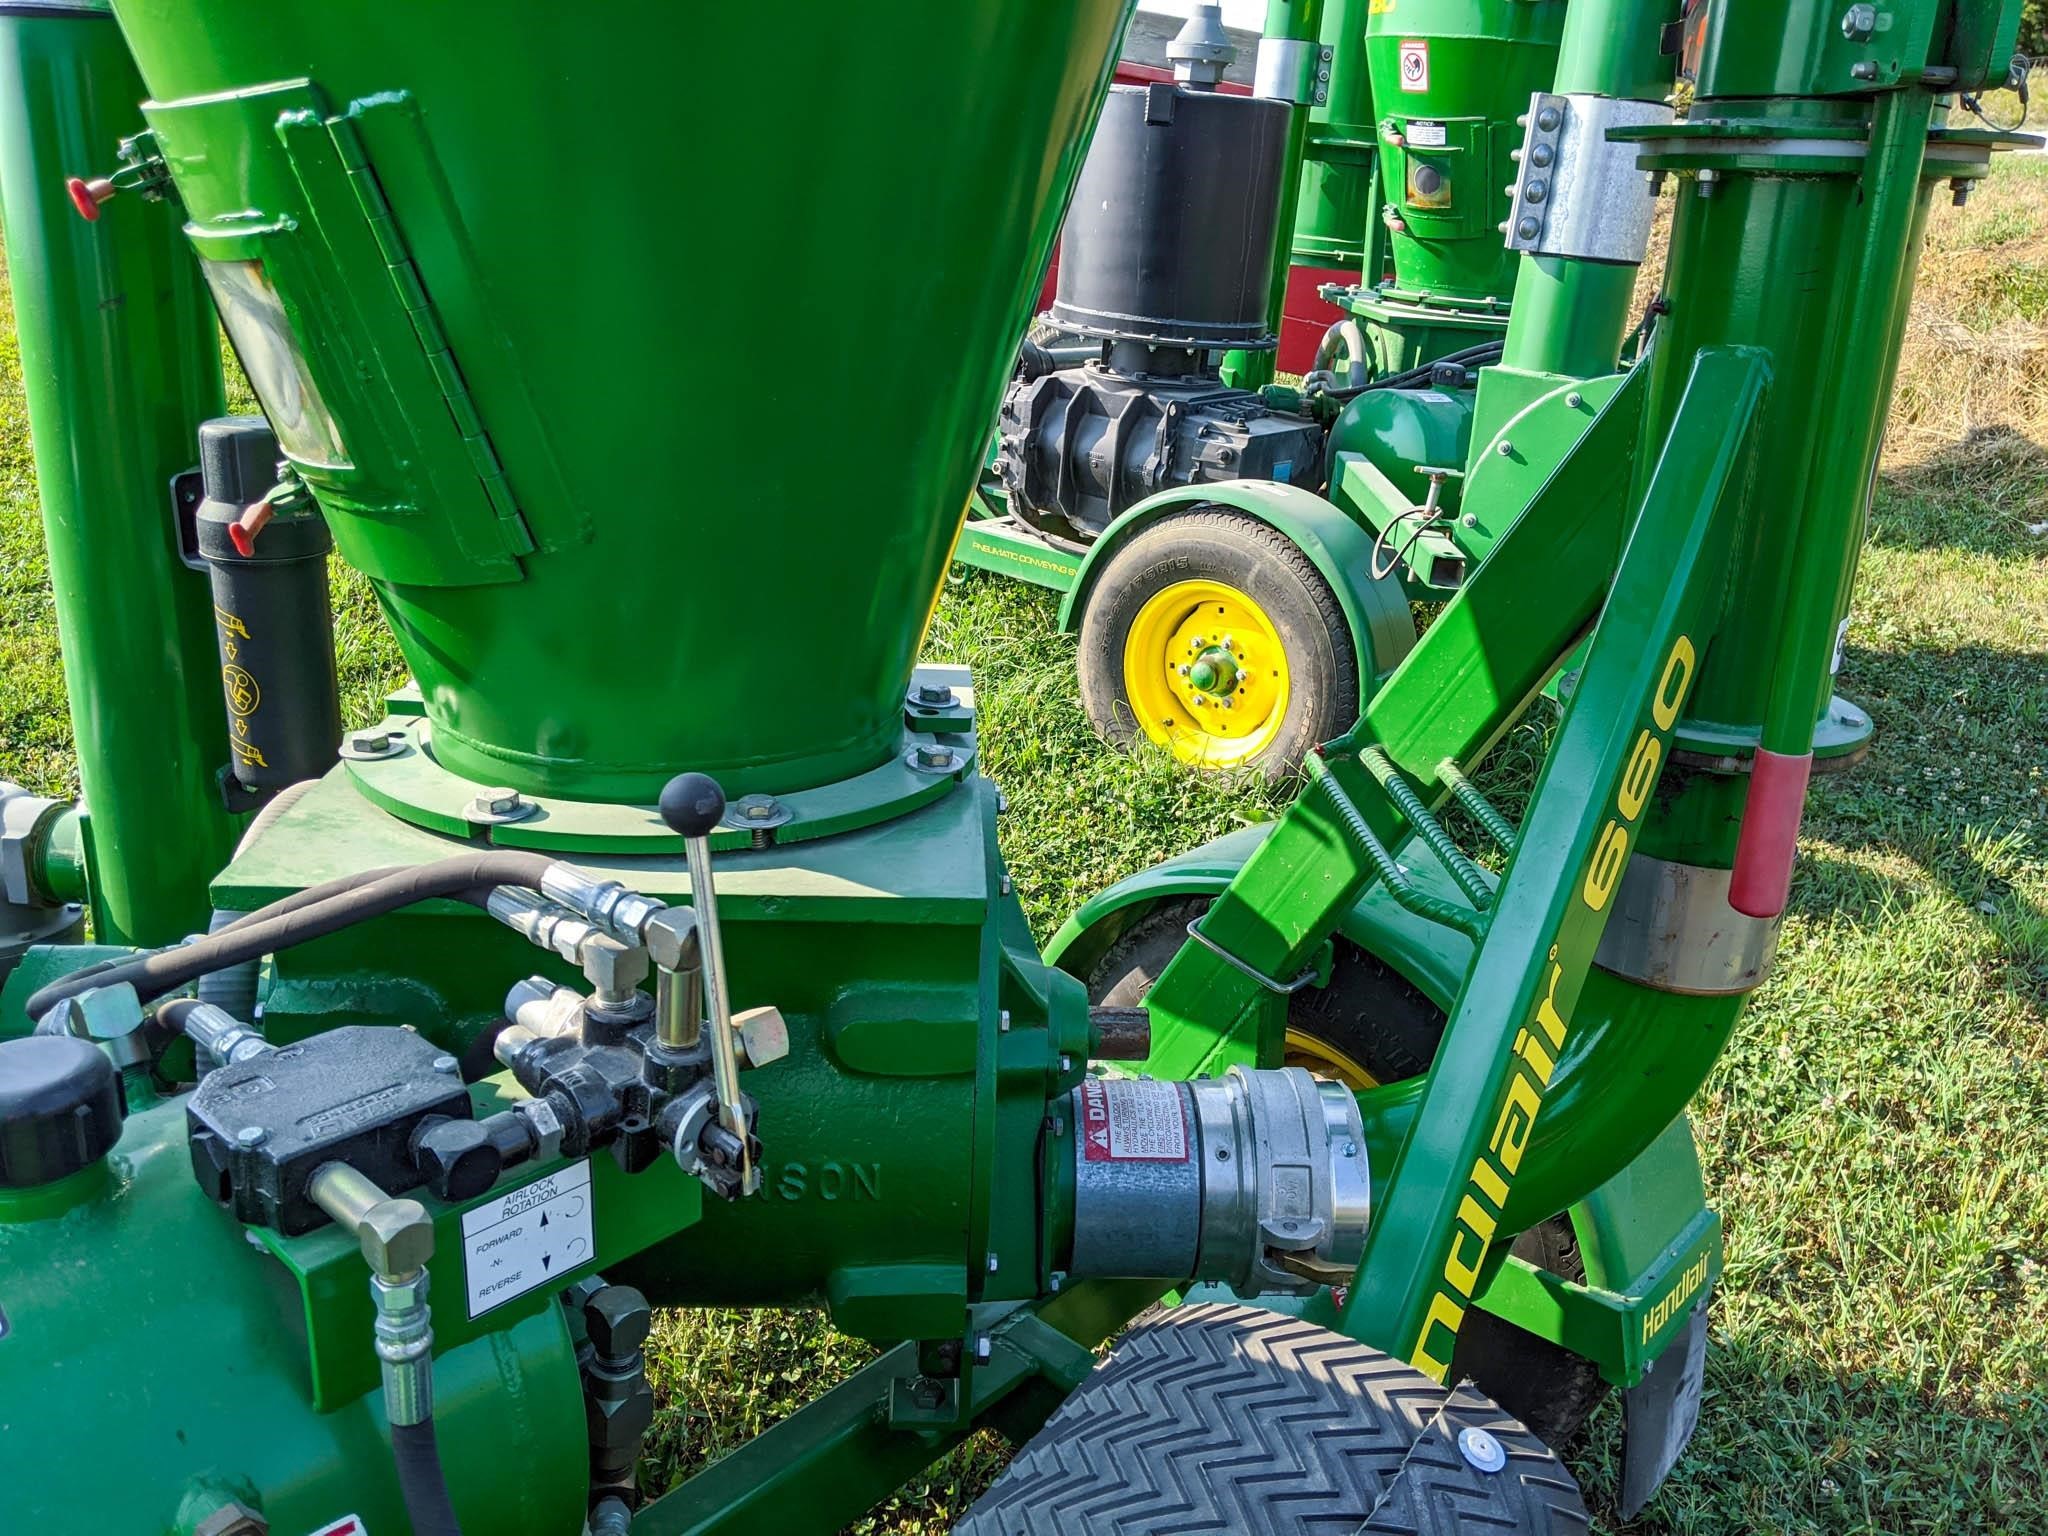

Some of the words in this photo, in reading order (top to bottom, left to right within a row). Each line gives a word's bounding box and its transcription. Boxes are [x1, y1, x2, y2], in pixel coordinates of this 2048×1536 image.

[972, 541, 1018, 561] PNEUMATIC
[1019, 554, 1068, 575] CONVEYING
[1409, 962, 1567, 1386] ndlair
[1583, 635, 1695, 912] 660
[1112, 1103, 1121, 1128] AIRLOCK
[1146, 1108, 1155, 1136] CYCLONE
[1154, 1101, 1164, 1131] SHUTTING
[1162, 1101, 1172, 1154] DISCONNECTING
[1171, 1112, 1179, 1129] YOUR
[1123, 1127, 1131, 1153] ALWAYS
[1130, 1110, 1139, 1153] HYDRAULICS
[1140, 1133, 1148, 1153] MOVE
[1157, 1132, 1165, 1153] FIRST
[1173, 1132, 1181, 1154] FROM
[502, 1186, 558, 1219] ROTATION
[503, 1175, 556, 1207] AIRLOCK
[475, 1227, 523, 1255] FORWARD
[478, 1271, 522, 1298] REVERSE
[1643, 1250, 1711, 1345] Handlair
